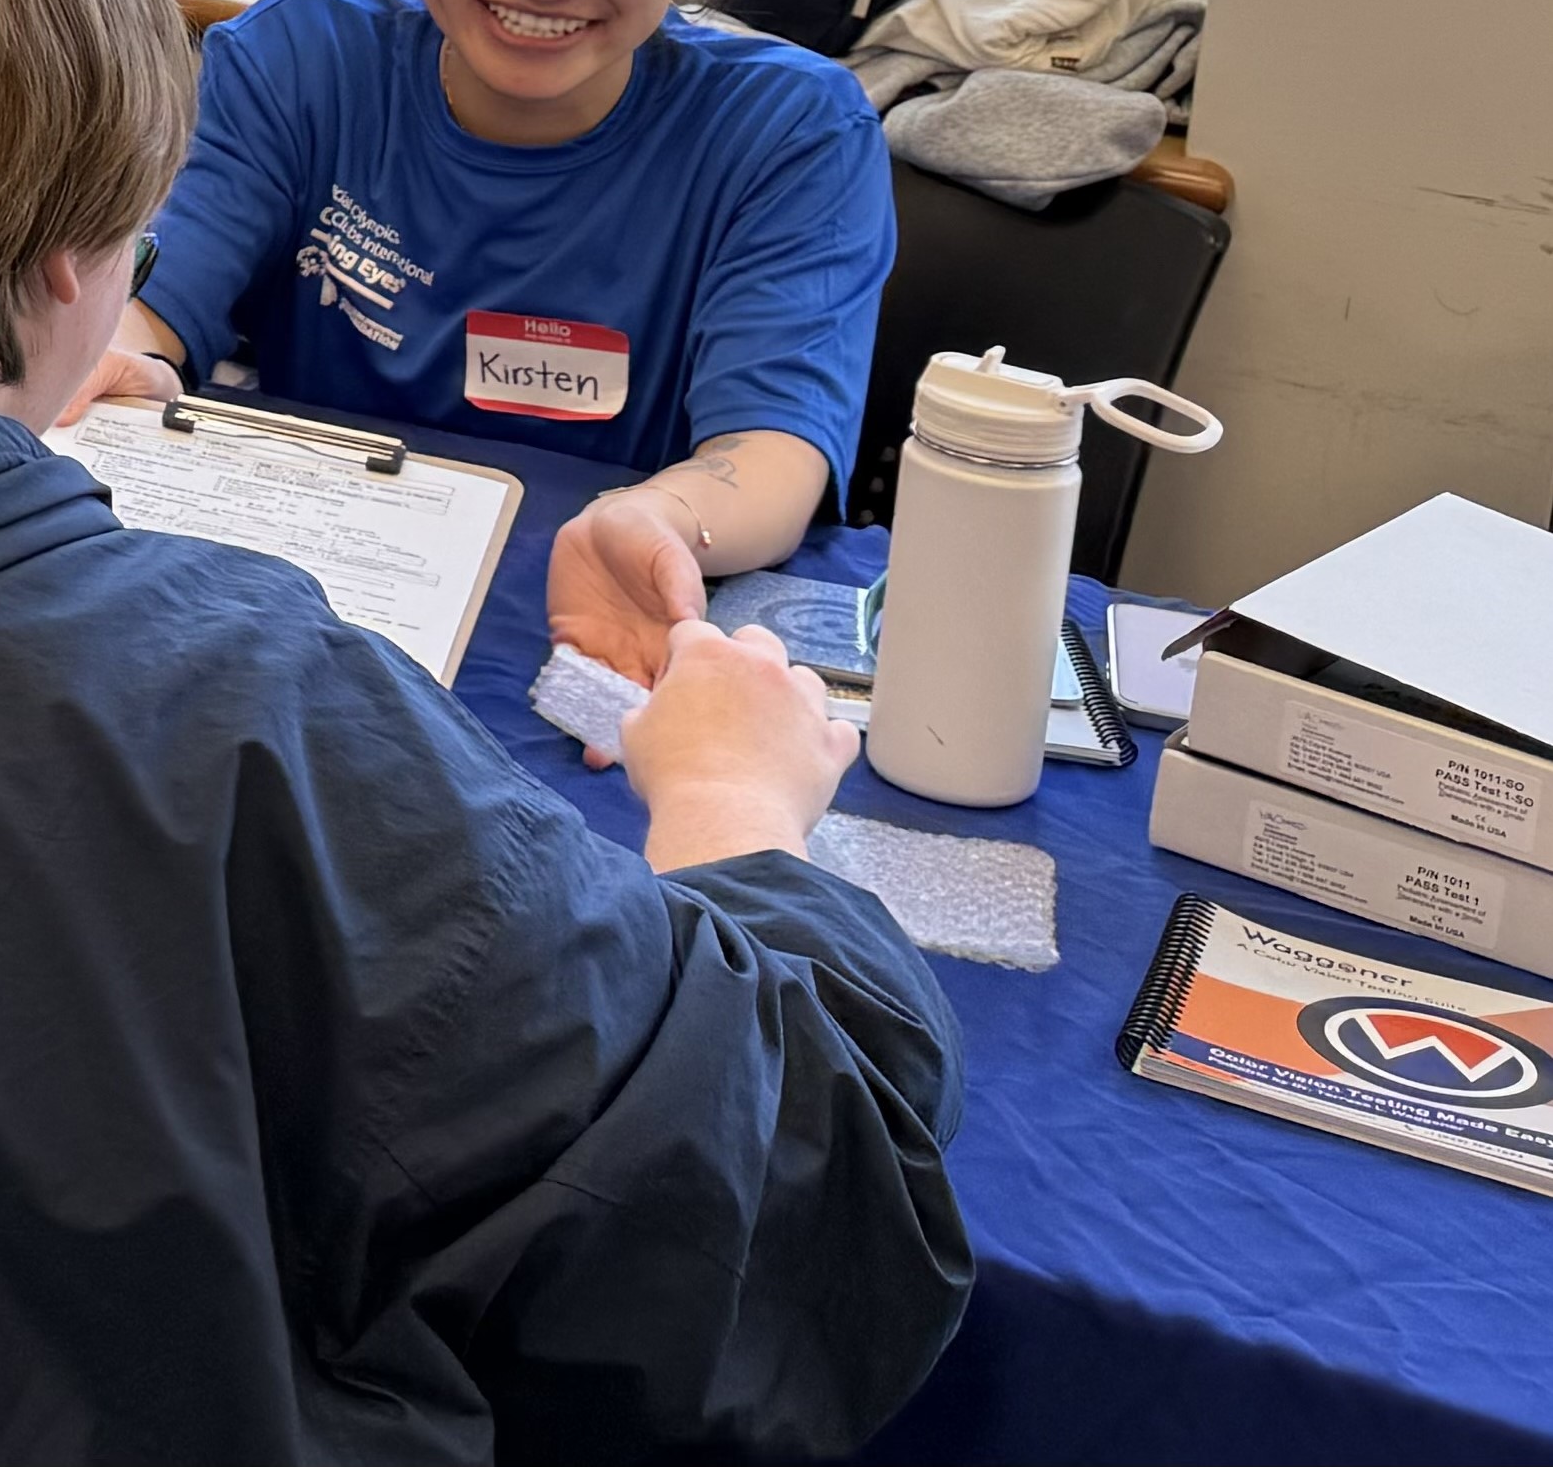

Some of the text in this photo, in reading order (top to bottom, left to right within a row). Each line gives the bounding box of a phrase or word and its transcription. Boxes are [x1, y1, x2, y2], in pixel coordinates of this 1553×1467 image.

[524, 318, 572, 337] Hello
[478, 351, 599, 401] Kirsten
[1435, 768, 1470, 787] PASS
[1474, 780, 1501, 797] Test
[1487, 825, 1507, 838] USA
[1405, 875, 1439, 893] PASS
[1444, 886, 1470, 903] Test
[1443, 874, 1470, 890] 1011
[1445, 927, 1465, 938] USA
[1242, 925, 1413, 986] Waggoner
[1209, 1047, 1268, 1072] Color
[1274, 1067, 1340, 1094] Vision
[1345, 1088, 1430, 1119] Testing
[1436, 1111, 1499, 1134] Made
